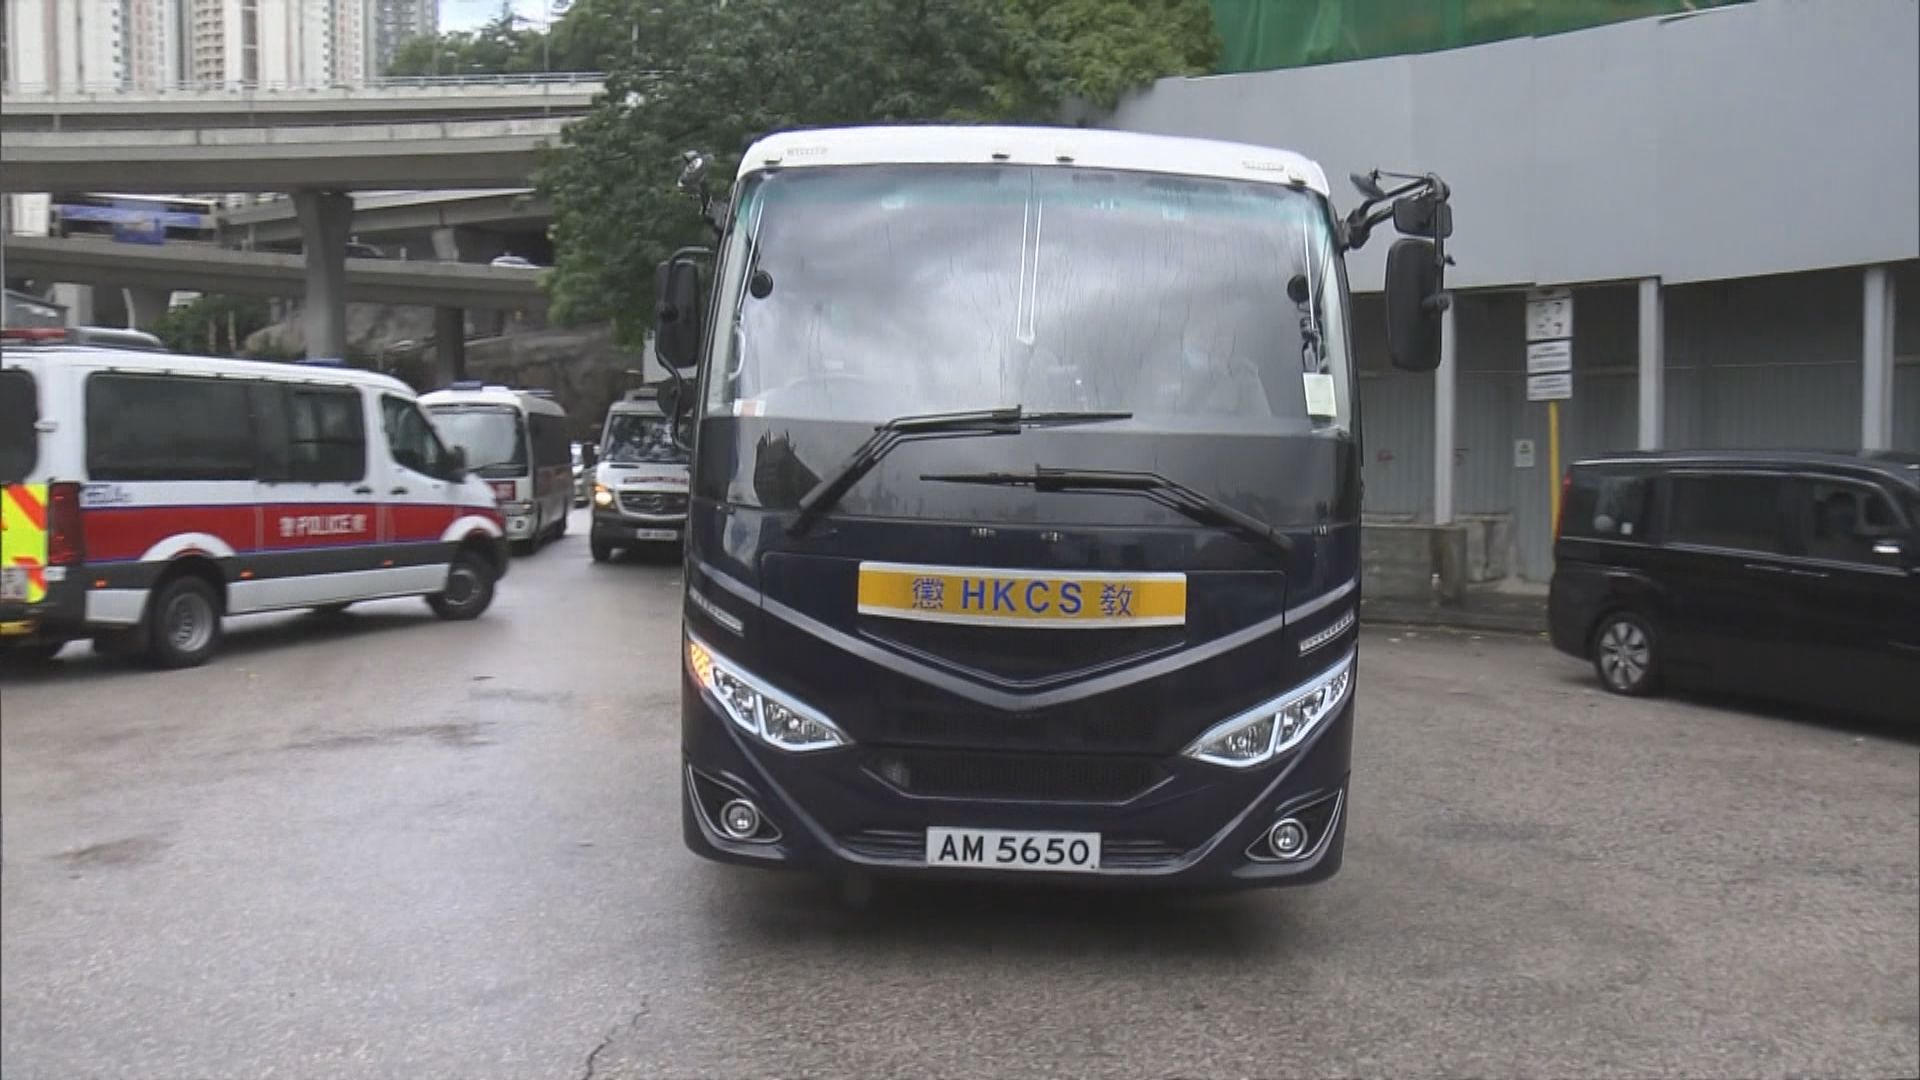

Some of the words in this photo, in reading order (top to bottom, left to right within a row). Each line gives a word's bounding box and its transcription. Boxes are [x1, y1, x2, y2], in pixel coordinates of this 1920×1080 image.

[961, 578, 1083, 615] HKCS
[938, 834, 985, 863] AM
[996, 836, 1090, 866] 5650
